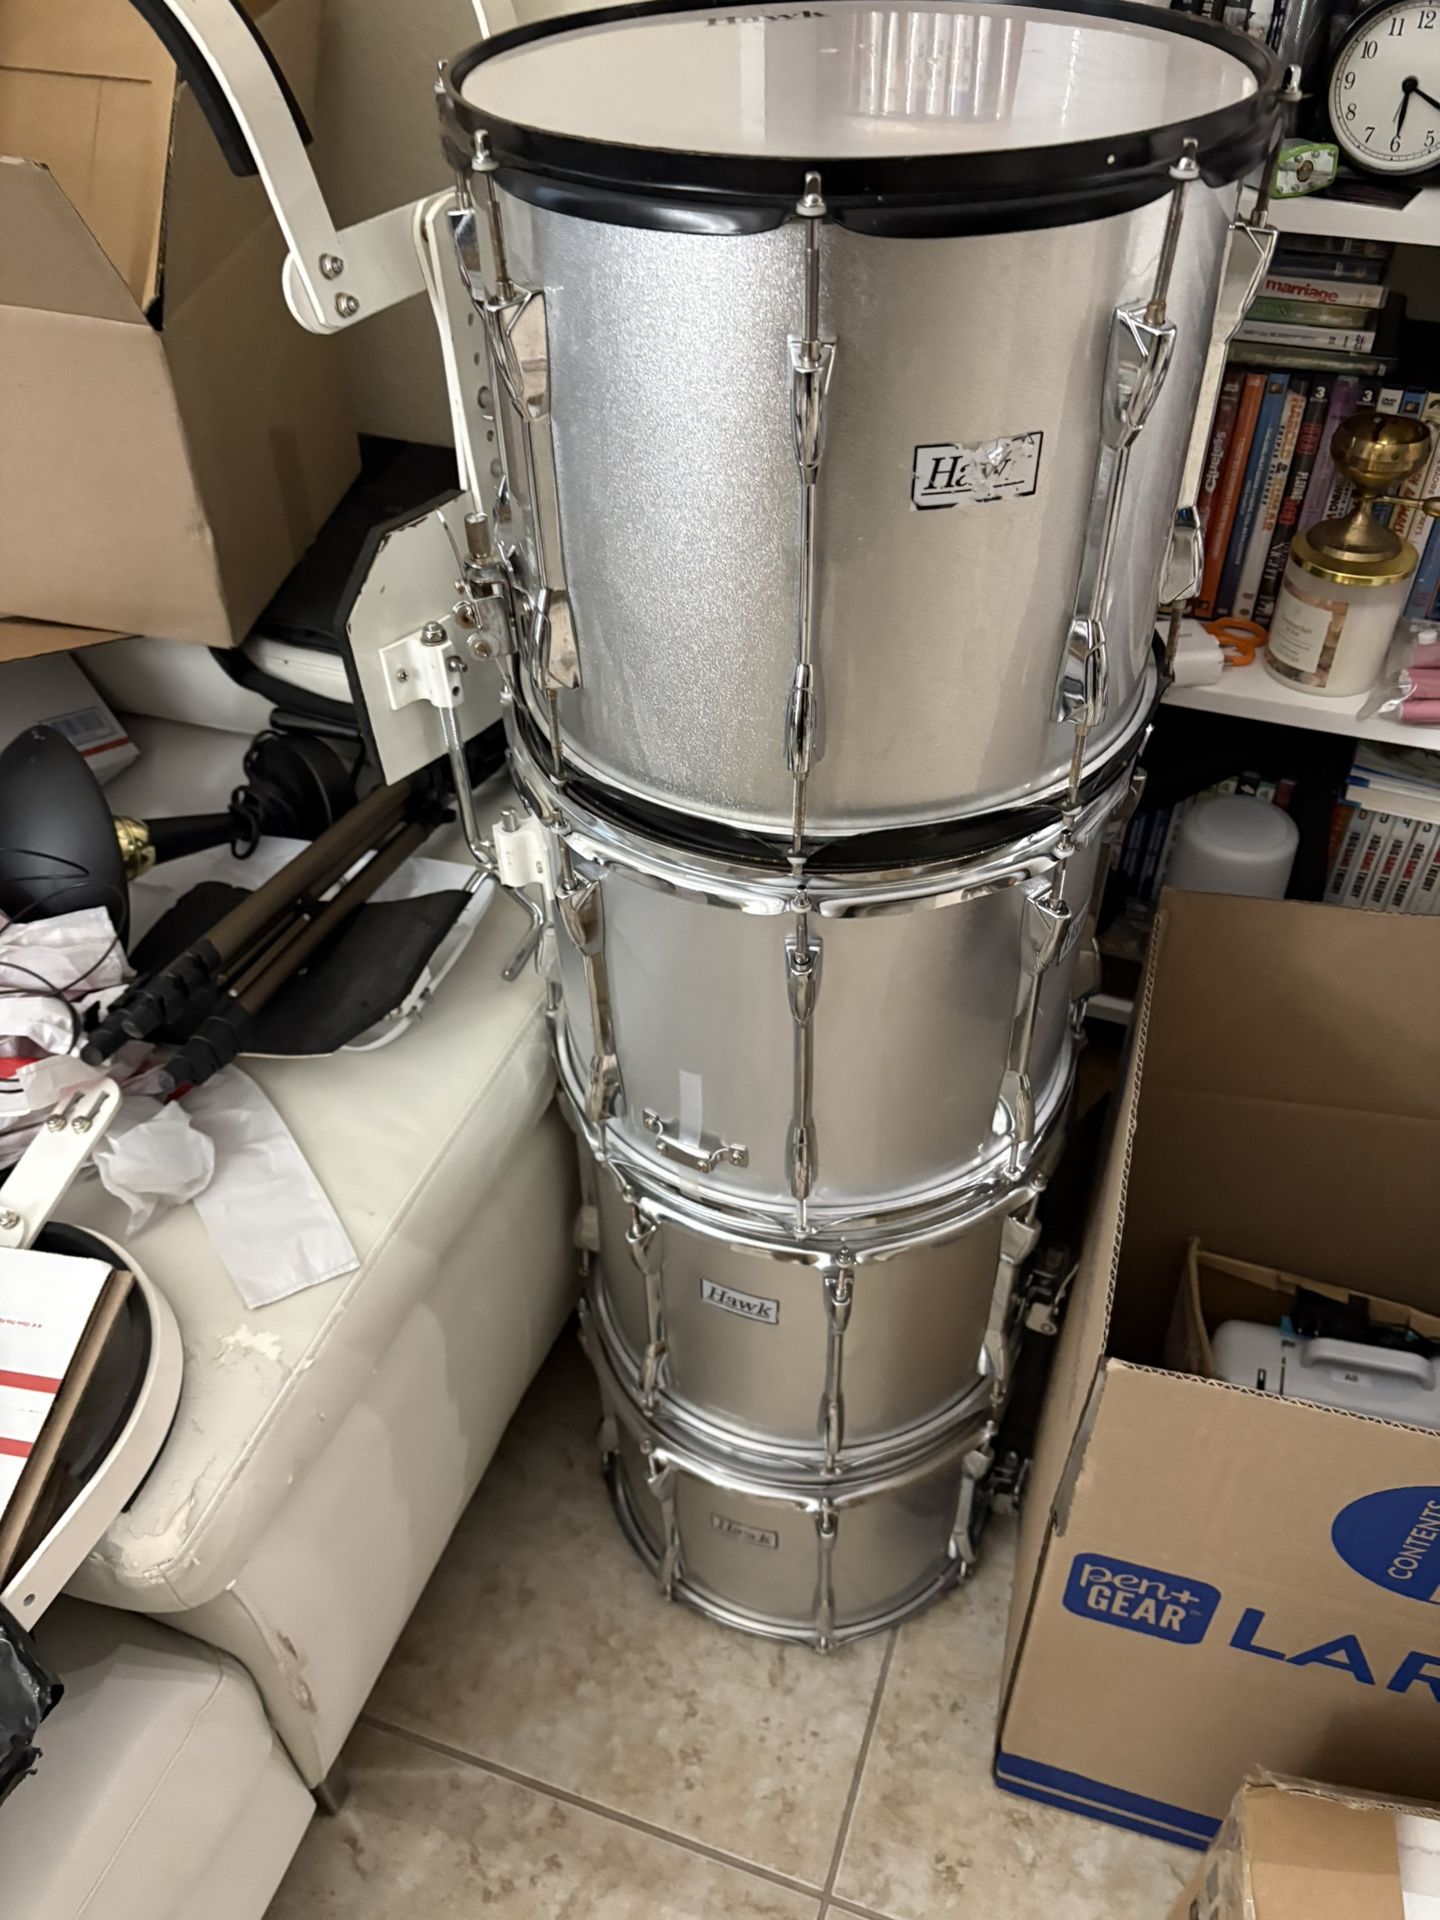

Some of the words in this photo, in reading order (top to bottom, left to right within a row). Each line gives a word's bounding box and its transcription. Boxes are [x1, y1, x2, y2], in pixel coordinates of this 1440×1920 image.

[1388, 17, 1405, 36] 11
[1417, 10, 1437, 30] 12
[1361, 40, 1378, 59] 10
[1344, 71, 1356, 90] 9
[1345, 103, 1357, 121] 8
[1364, 126, 1376, 143] 7
[1389, 135, 1402, 153] 6
[1423, 130, 1436, 147] 5
[1265, 277, 1339, 303] marriage
[1315, 386, 1326, 398] 3
[1362, 390, 1374, 402] 3
[1205, 431, 1227, 494] Clueless
[706, 1285, 774, 1318] Hawk
[1387, 1499, 1440, 1581] CONTENTS
[1087, 1583, 1187, 1633] GEAR
[1229, 1606, 1440, 1704] LAR
